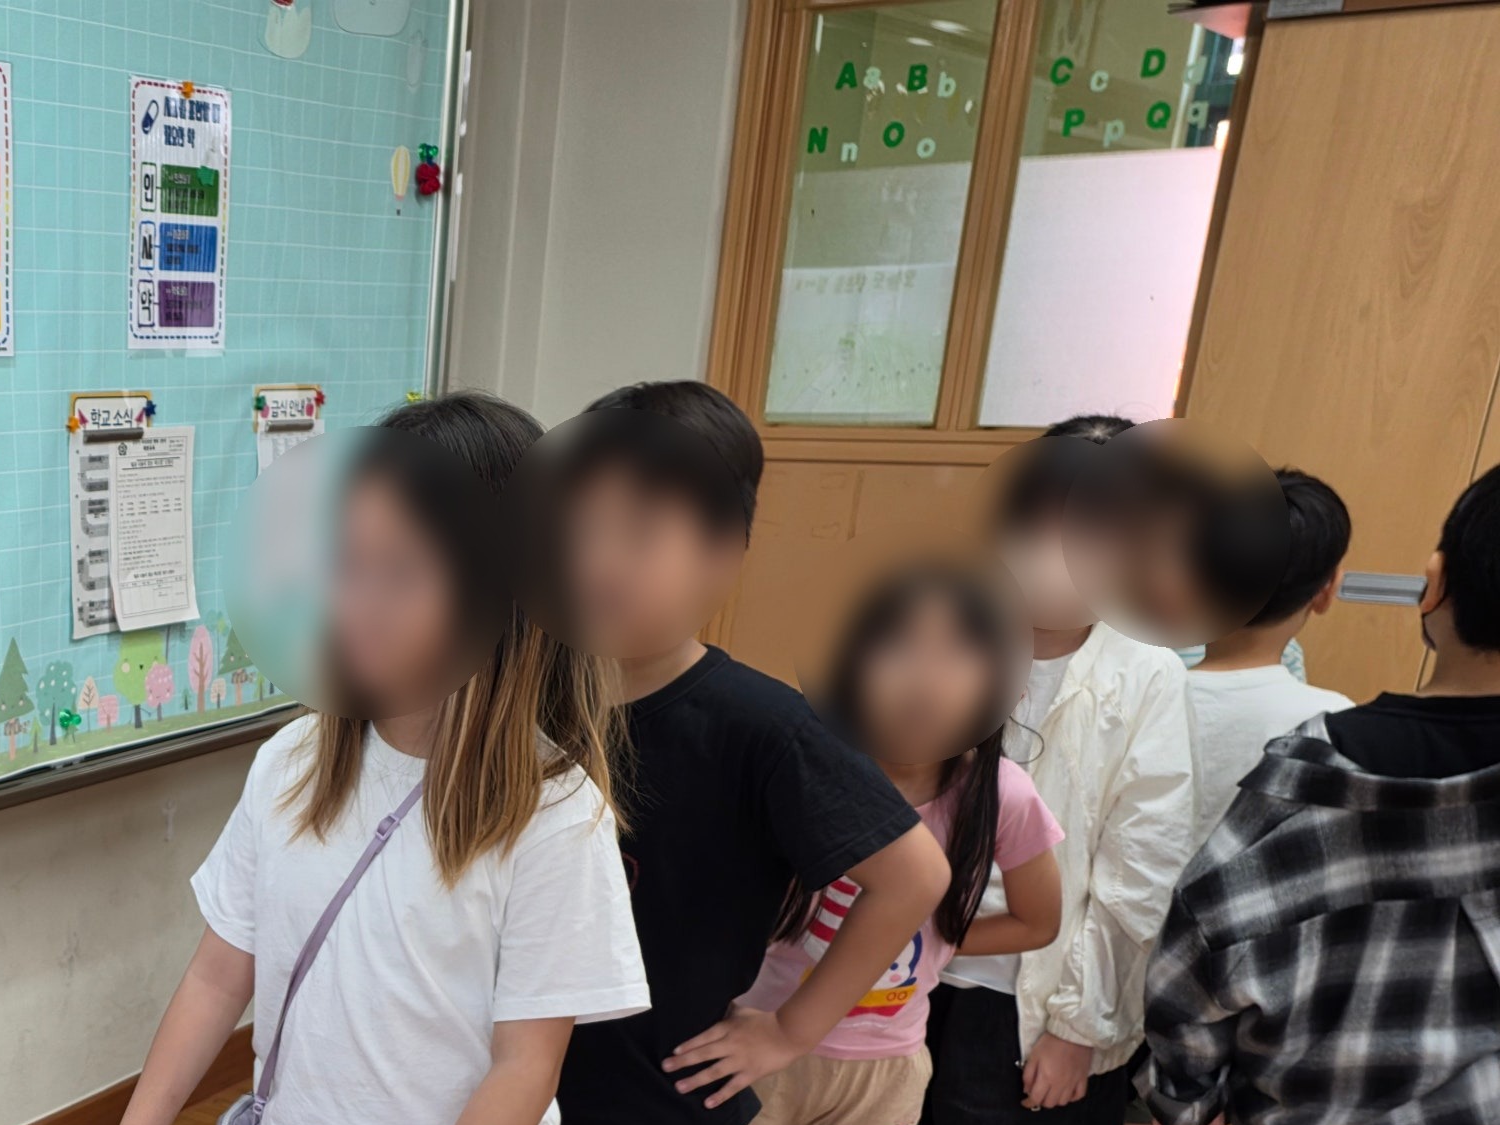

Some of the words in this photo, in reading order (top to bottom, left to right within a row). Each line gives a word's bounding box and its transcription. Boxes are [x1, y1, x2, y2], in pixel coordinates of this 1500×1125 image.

[835, 61, 857, 90] A
[907, 63, 928, 91] B
[937, 71, 956, 97] b
[1050, 57, 1074, 86] C
[1089, 70, 1109, 92] c
[1140, 48, 1166, 78] D
[1062, 108, 1085, 137] P
[1146, 101, 1171, 129] Q
[807, 126, 829, 154] N
[840, 142, 858, 162] n
[144, 173, 154, 203] 인
[140, 288, 153, 322] 약
[91, 408, 111, 428] 학교
[113, 408, 133, 428] 소식
